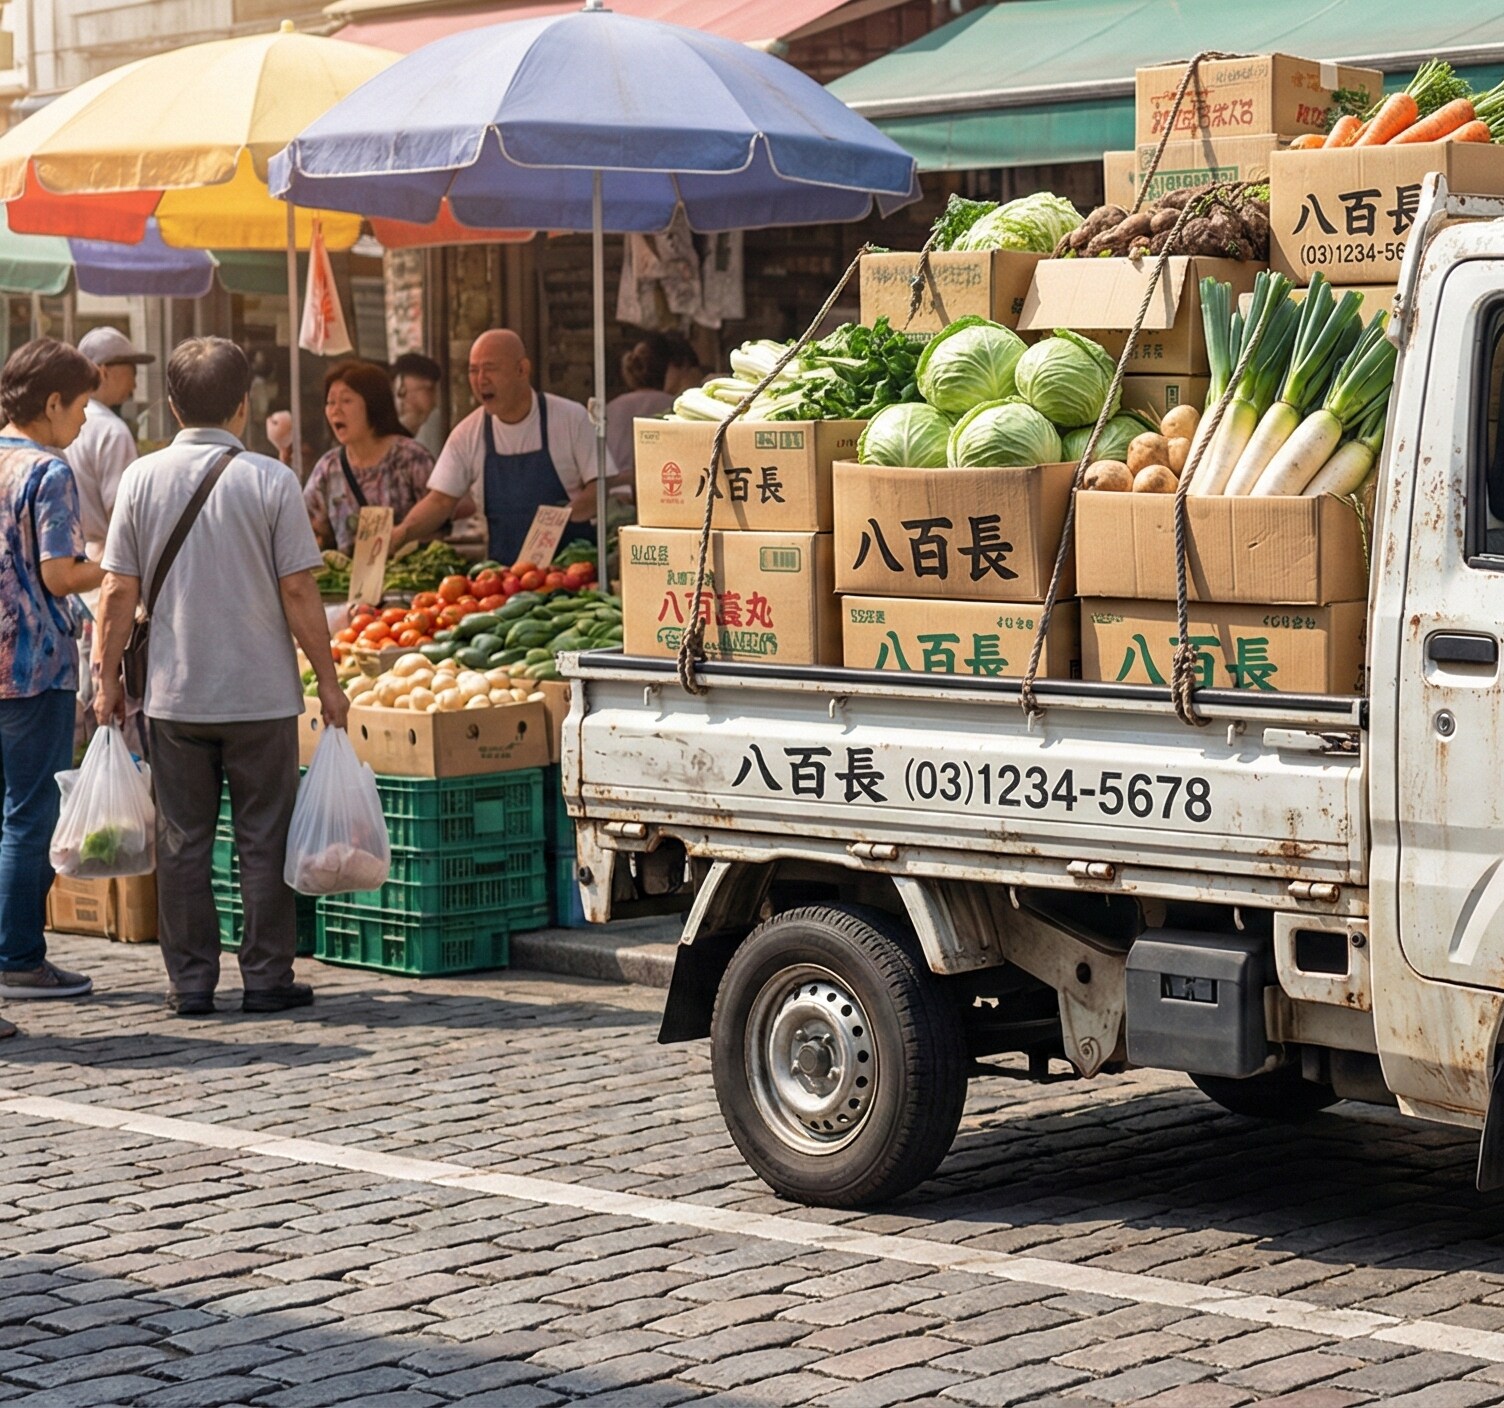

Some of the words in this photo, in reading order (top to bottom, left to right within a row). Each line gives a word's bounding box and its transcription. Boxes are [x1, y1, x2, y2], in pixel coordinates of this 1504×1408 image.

[1292, 183, 1422, 236] 八百長
[852, 513, 1020, 583] 八百長
[875, 630, 1010, 678] 八百長
[1115, 633, 1279, 691] 八百長
[731, 743, 888, 803] 八百長
[904, 757, 1213, 823] (03)1234-5678
